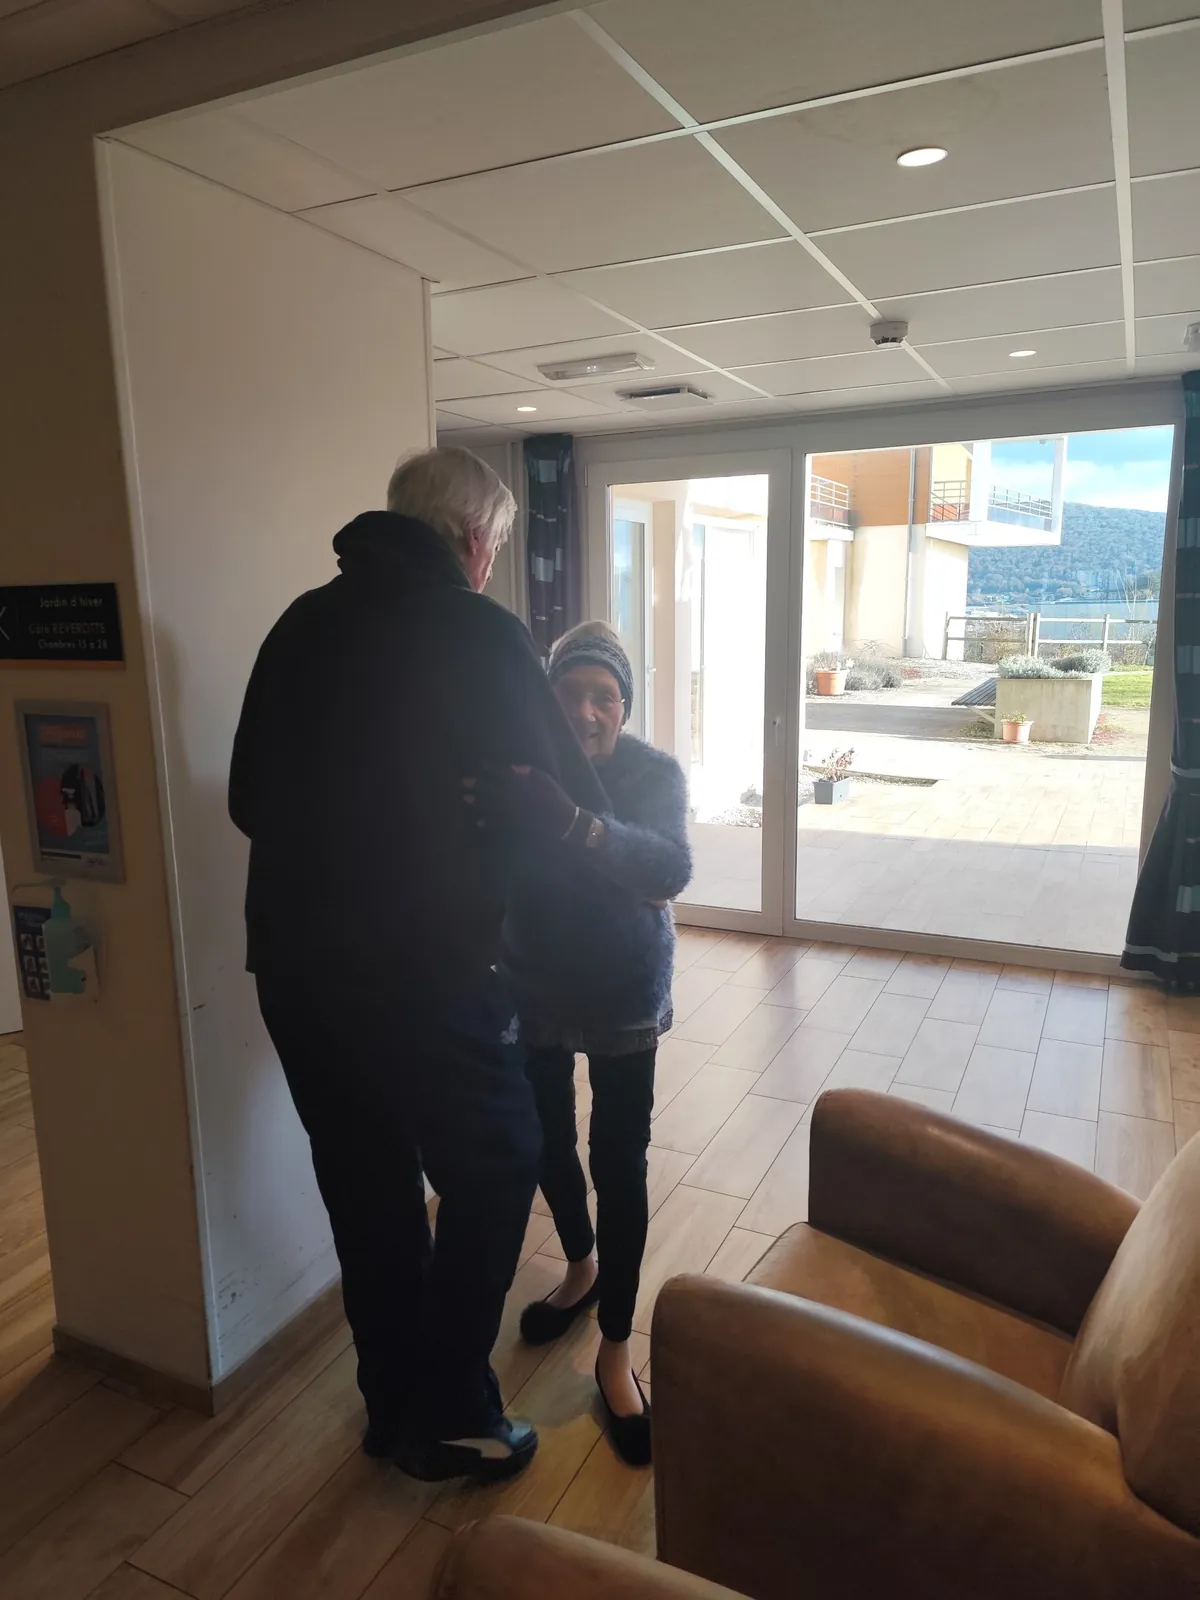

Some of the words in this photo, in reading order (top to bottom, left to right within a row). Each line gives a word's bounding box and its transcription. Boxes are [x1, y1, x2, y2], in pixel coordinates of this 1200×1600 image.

[40, 595, 67, 608] Jardin
[38, 638, 75, 649] Chambres
[78, 638, 87, 649] 15
